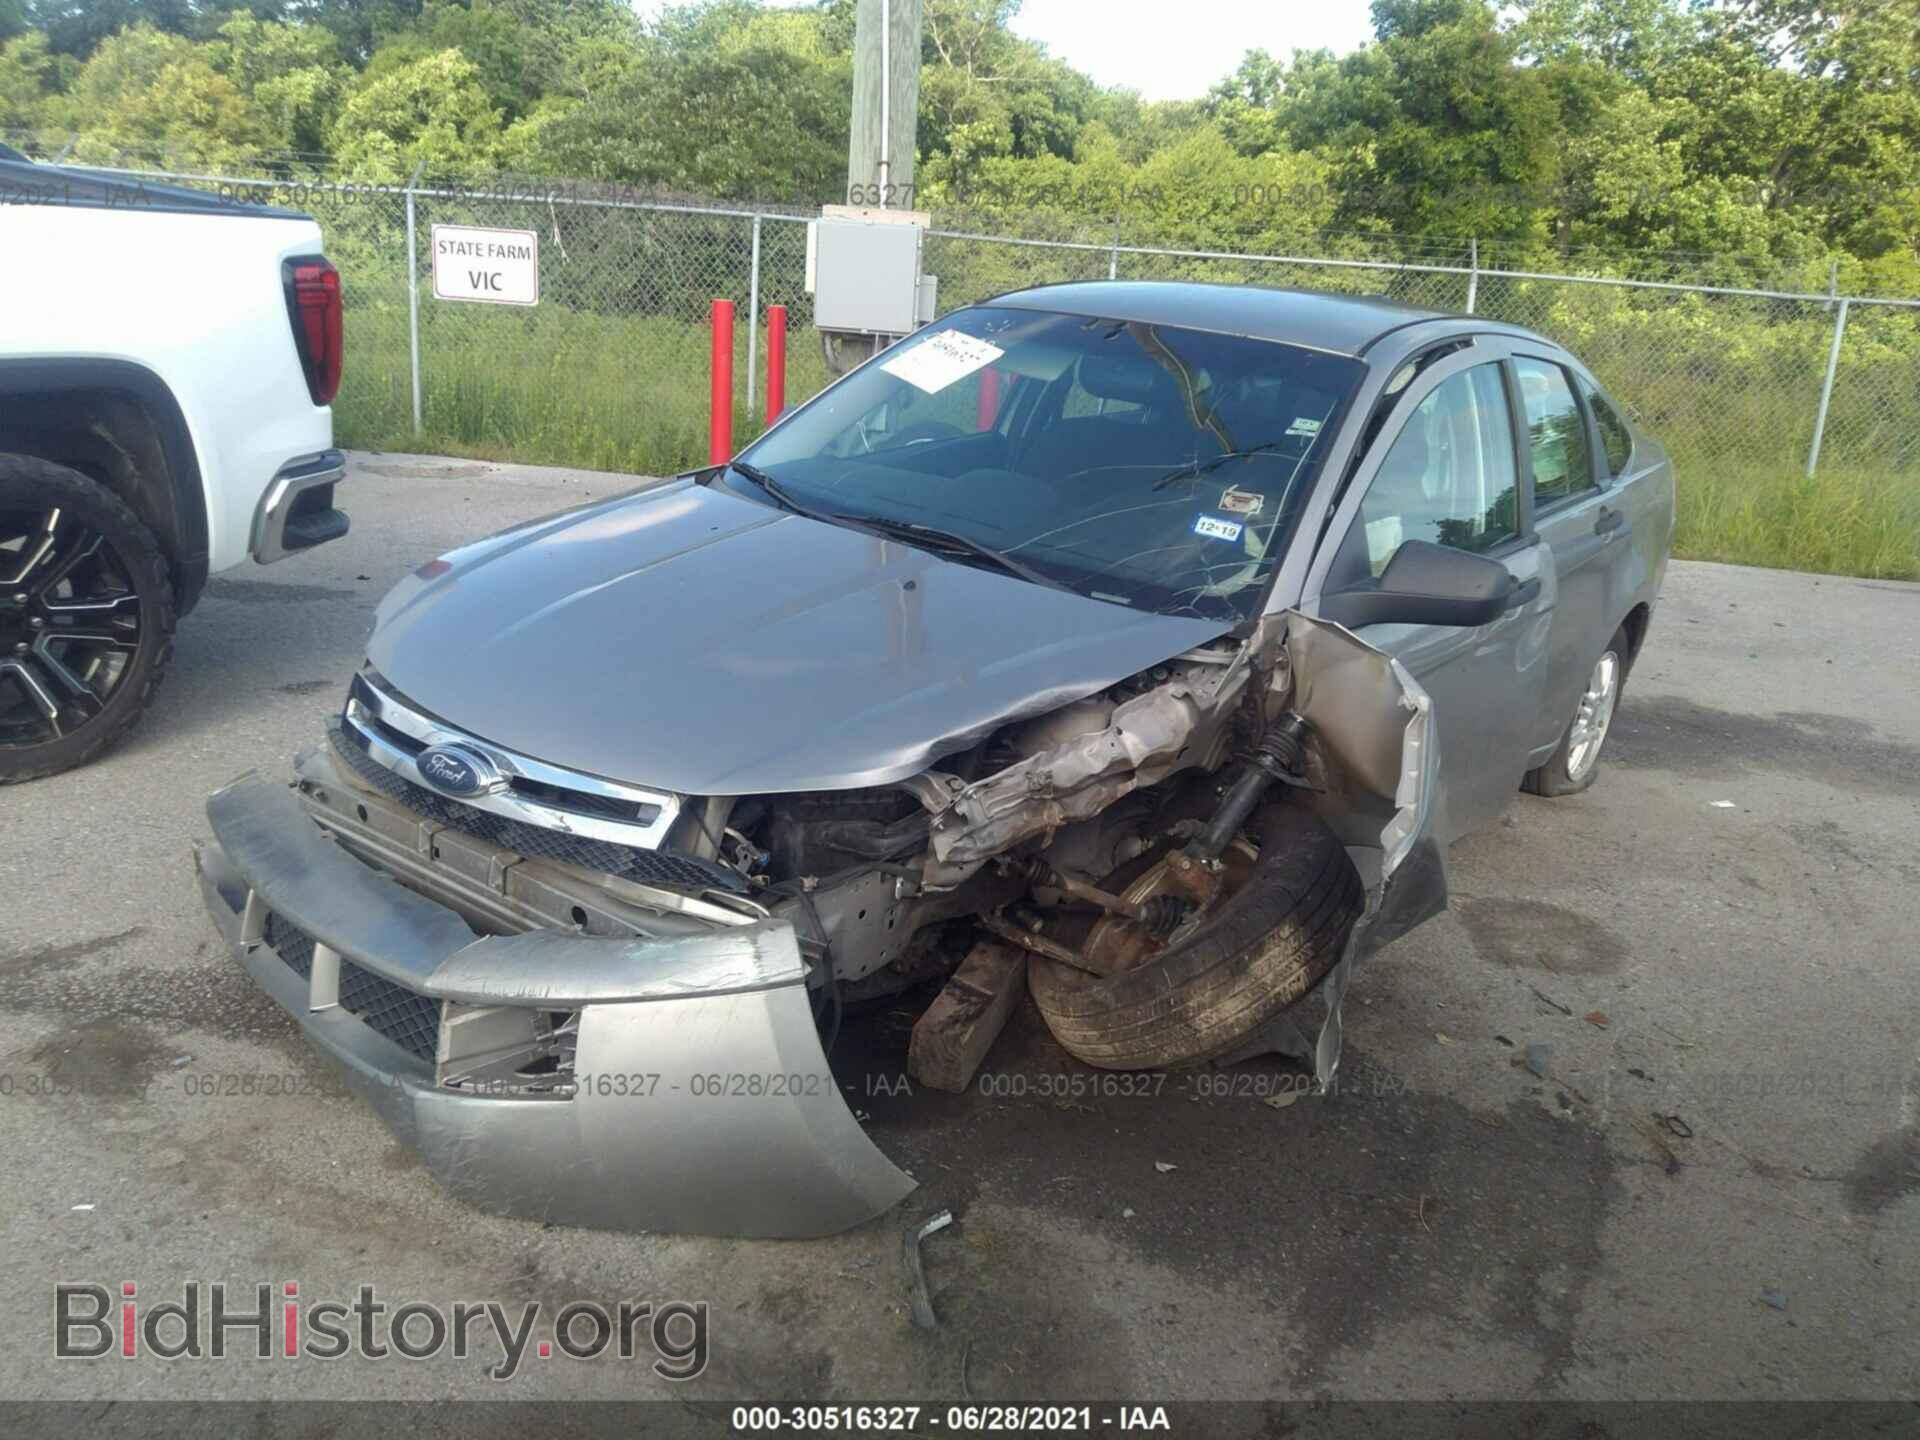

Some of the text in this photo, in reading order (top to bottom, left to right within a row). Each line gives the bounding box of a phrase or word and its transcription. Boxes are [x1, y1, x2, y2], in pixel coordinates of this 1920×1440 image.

[438, 240, 531, 260] STATE FARM
[468, 270, 503, 291] VIC
[425, 753, 468, 785] Ford
